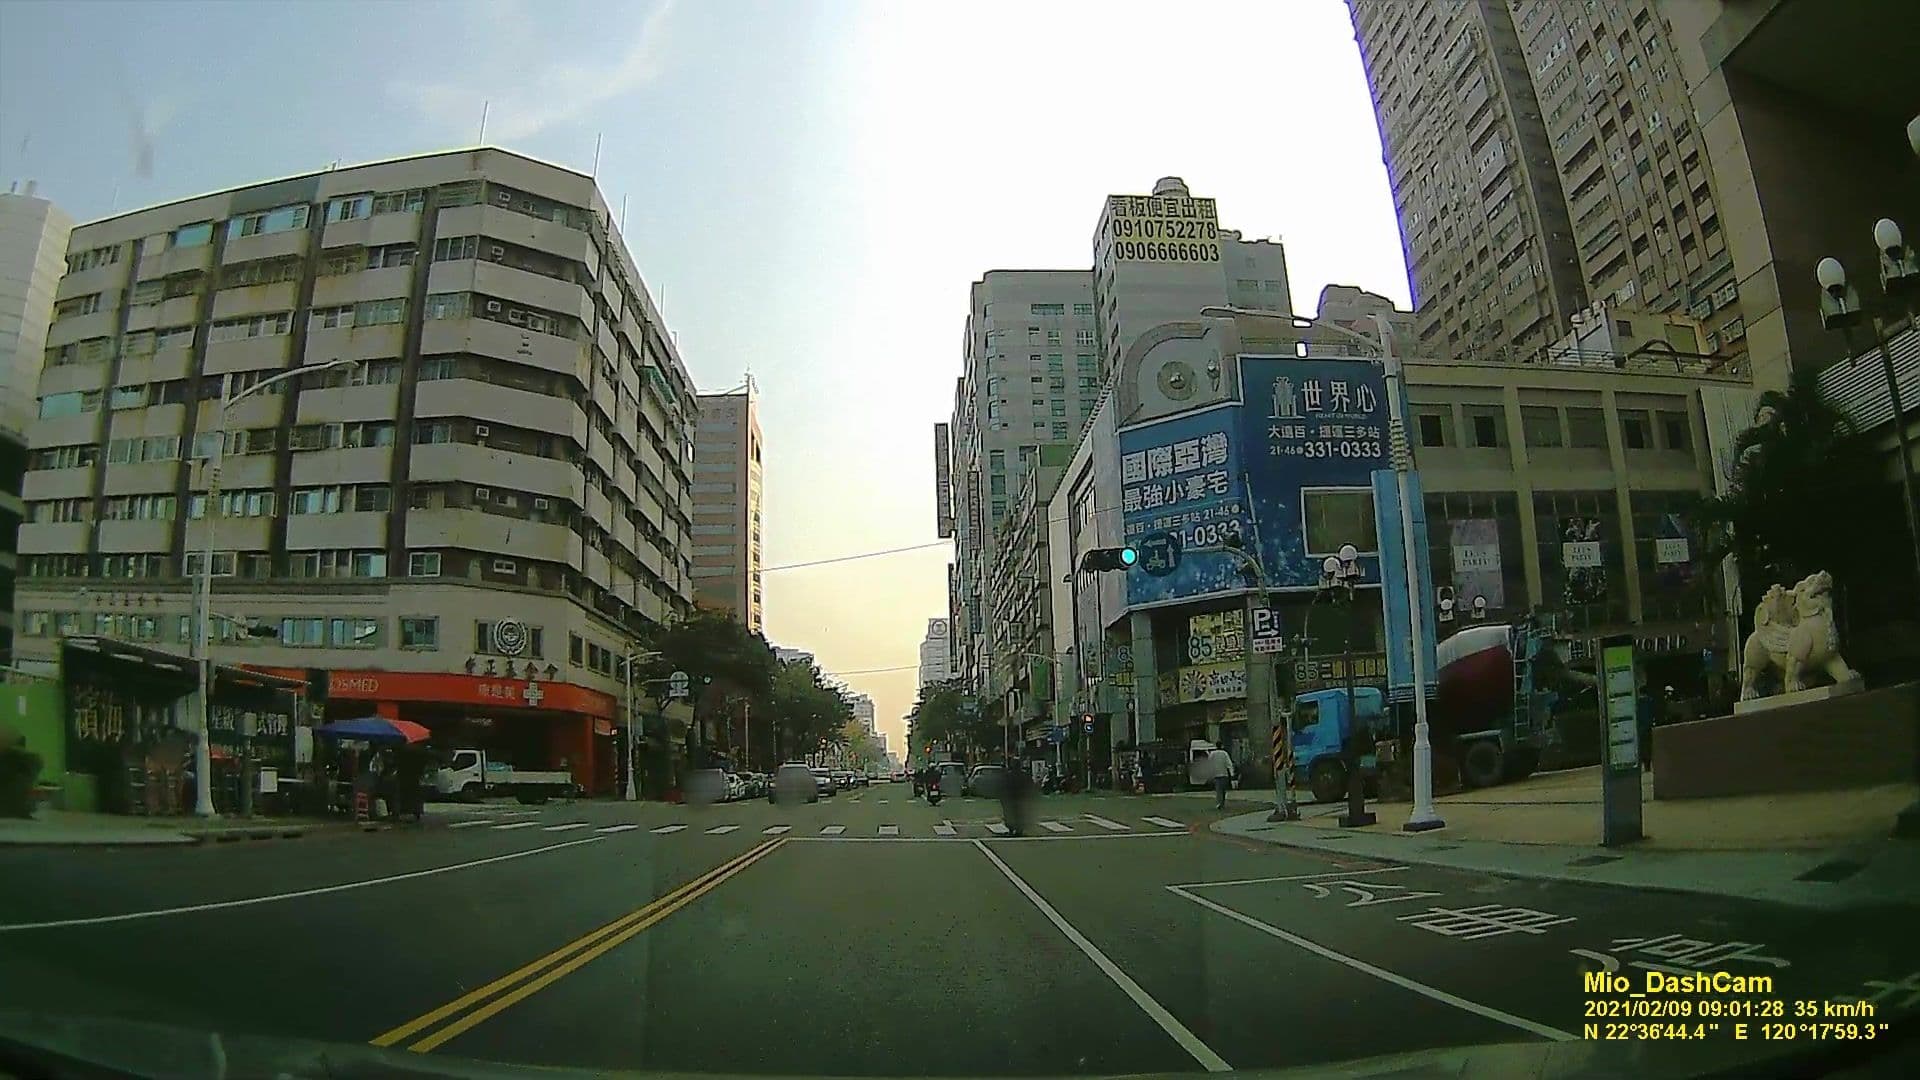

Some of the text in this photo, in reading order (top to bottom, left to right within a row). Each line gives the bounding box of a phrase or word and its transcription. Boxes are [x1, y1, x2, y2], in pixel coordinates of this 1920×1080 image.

[1111, 197, 1215, 219] 看板便宜出租
[1113, 219, 1217, 240] 0910752278
[1115, 241, 1220, 262] 0906666603
[1301, 379, 1377, 413] 世界心
[1122, 431, 1228, 485] 國際亞灣
[1304, 440, 1382, 458] 331-0333
[1122, 469, 1228, 513] 最強小豪宅
[1253, 608, 1272, 631] P
[1189, 635, 1213, 659] 85
[1295, 661, 1319, 682] 85
